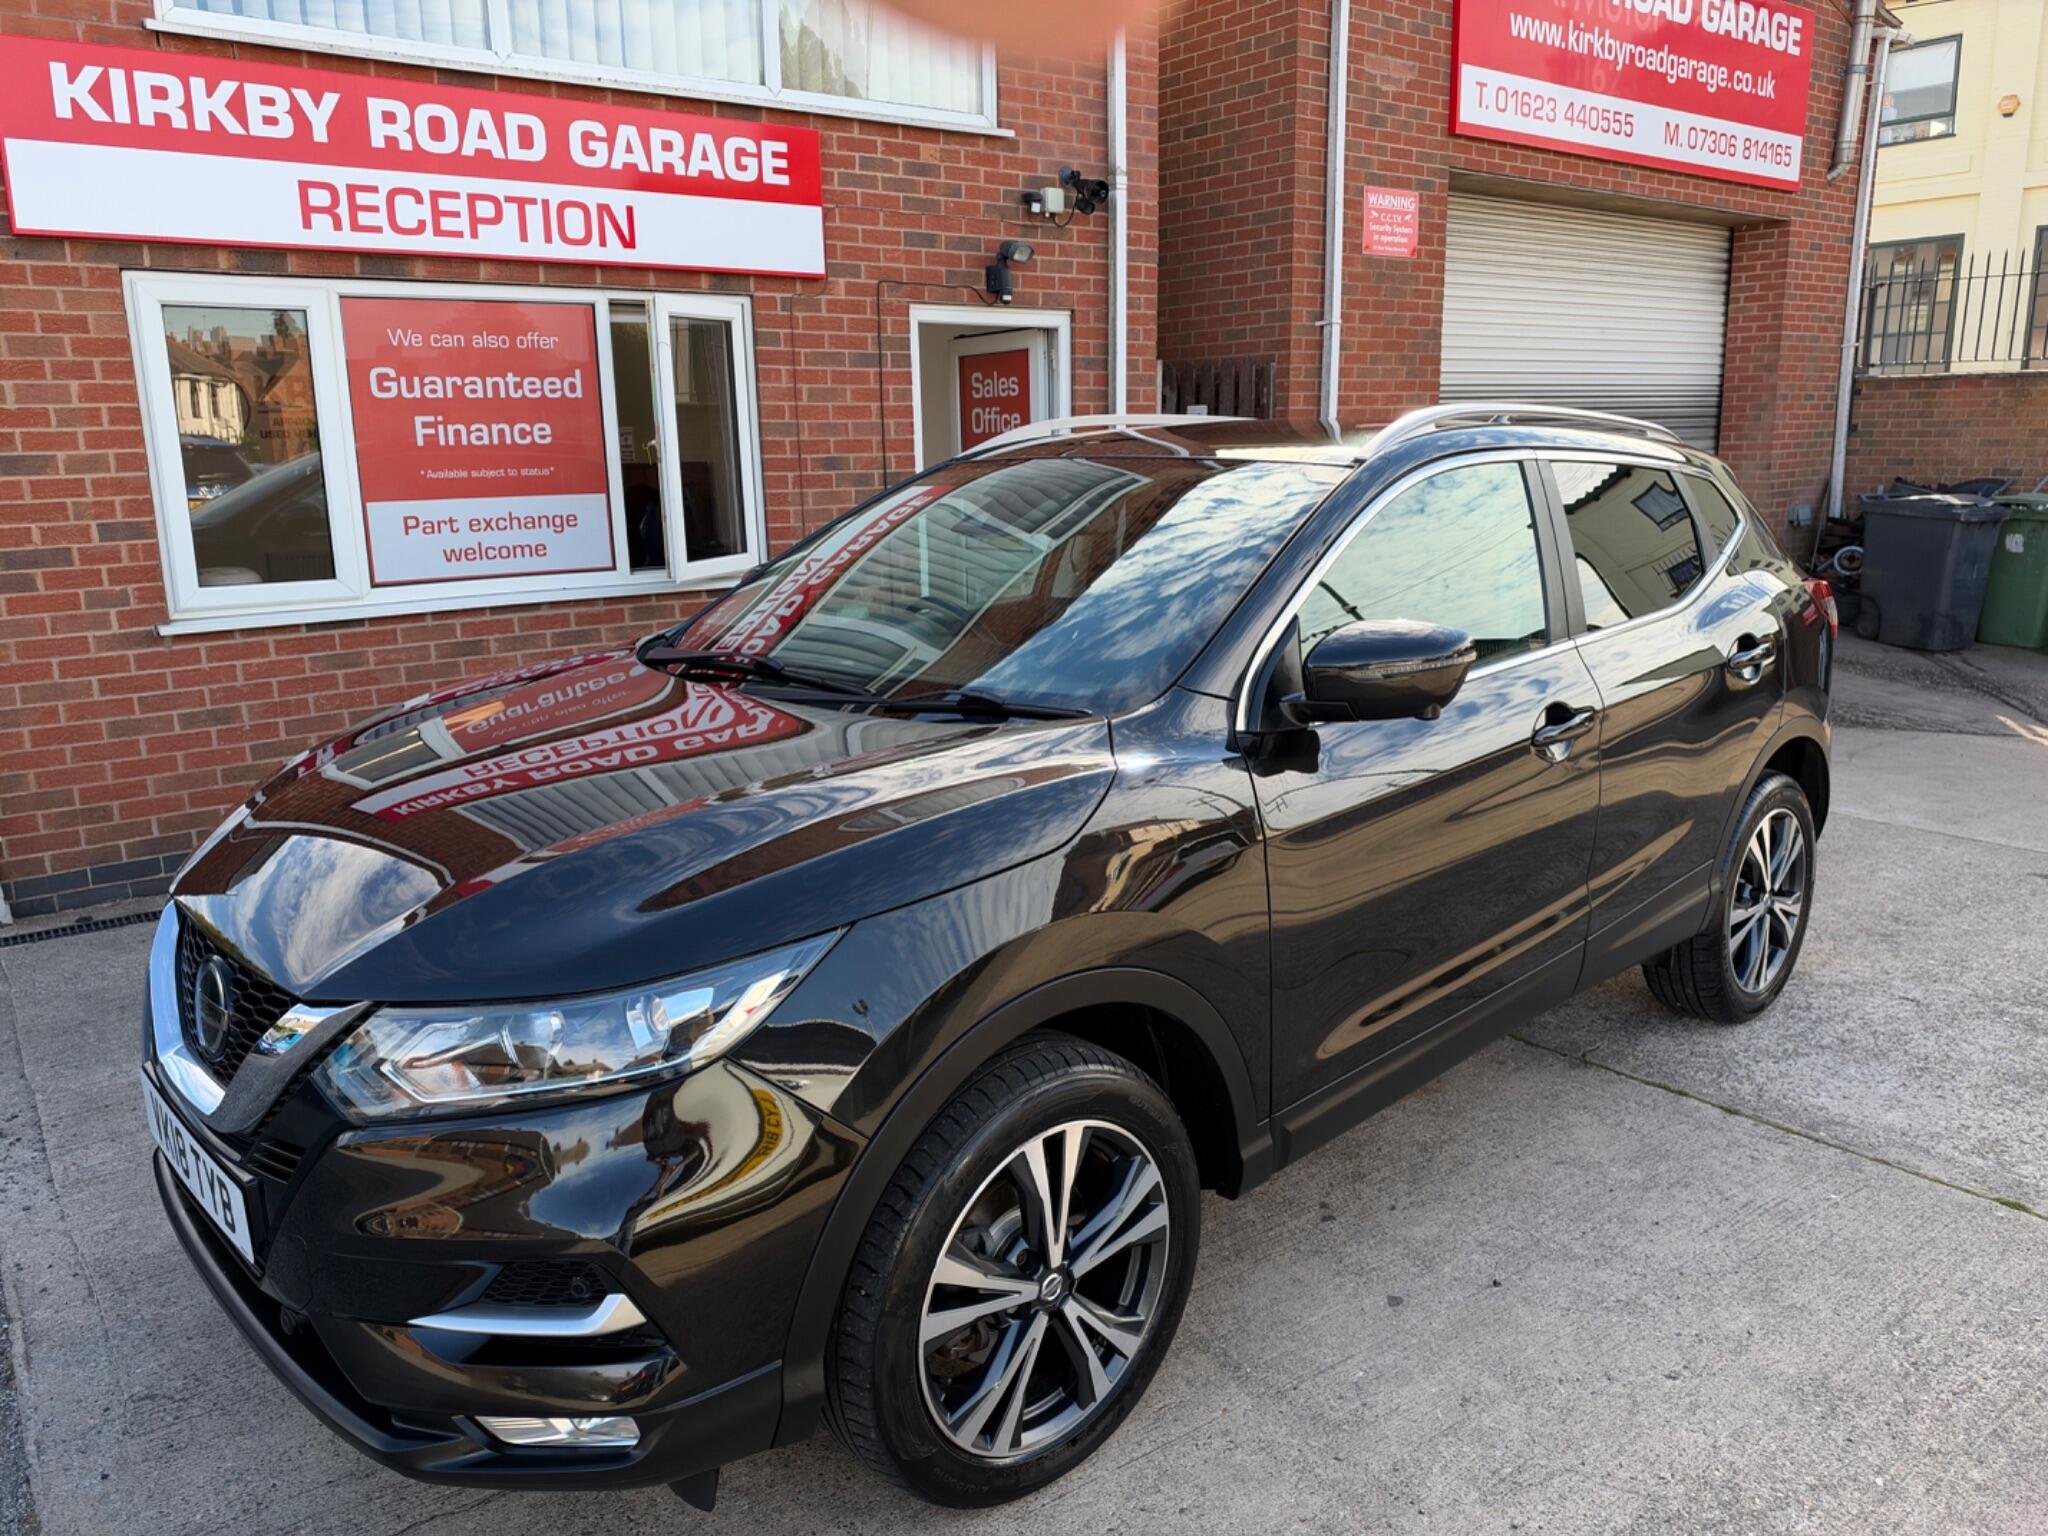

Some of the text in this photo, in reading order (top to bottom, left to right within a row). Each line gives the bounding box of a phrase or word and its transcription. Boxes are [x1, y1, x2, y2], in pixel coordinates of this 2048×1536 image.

[1701, 0, 1802, 56] GARAGE
[1509, 12, 1776, 100] www.kirkbyroadgarage.co.uk
[49, 61, 791, 186] KIRKBY ROAD GARAGE
[1475, 81, 1792, 168] T. 01623 440555 M. 07306 814165
[297, 179, 637, 251] RECEPTION
[1368, 193, 1415, 210] WARNING
[387, 328, 559, 350] We can also offer
[369, 366, 583, 399] Guaranteed
[971, 371, 1019, 398] Sales
[414, 414, 553, 447] Finance
[971, 406, 1021, 434] Office
[471, 468, 506, 480] subject
[507, 468, 518, 477] to
[402, 511, 579, 536] Part exchange
[443, 541, 548, 563] welcome
[190, 1145, 236, 1234] TYB
